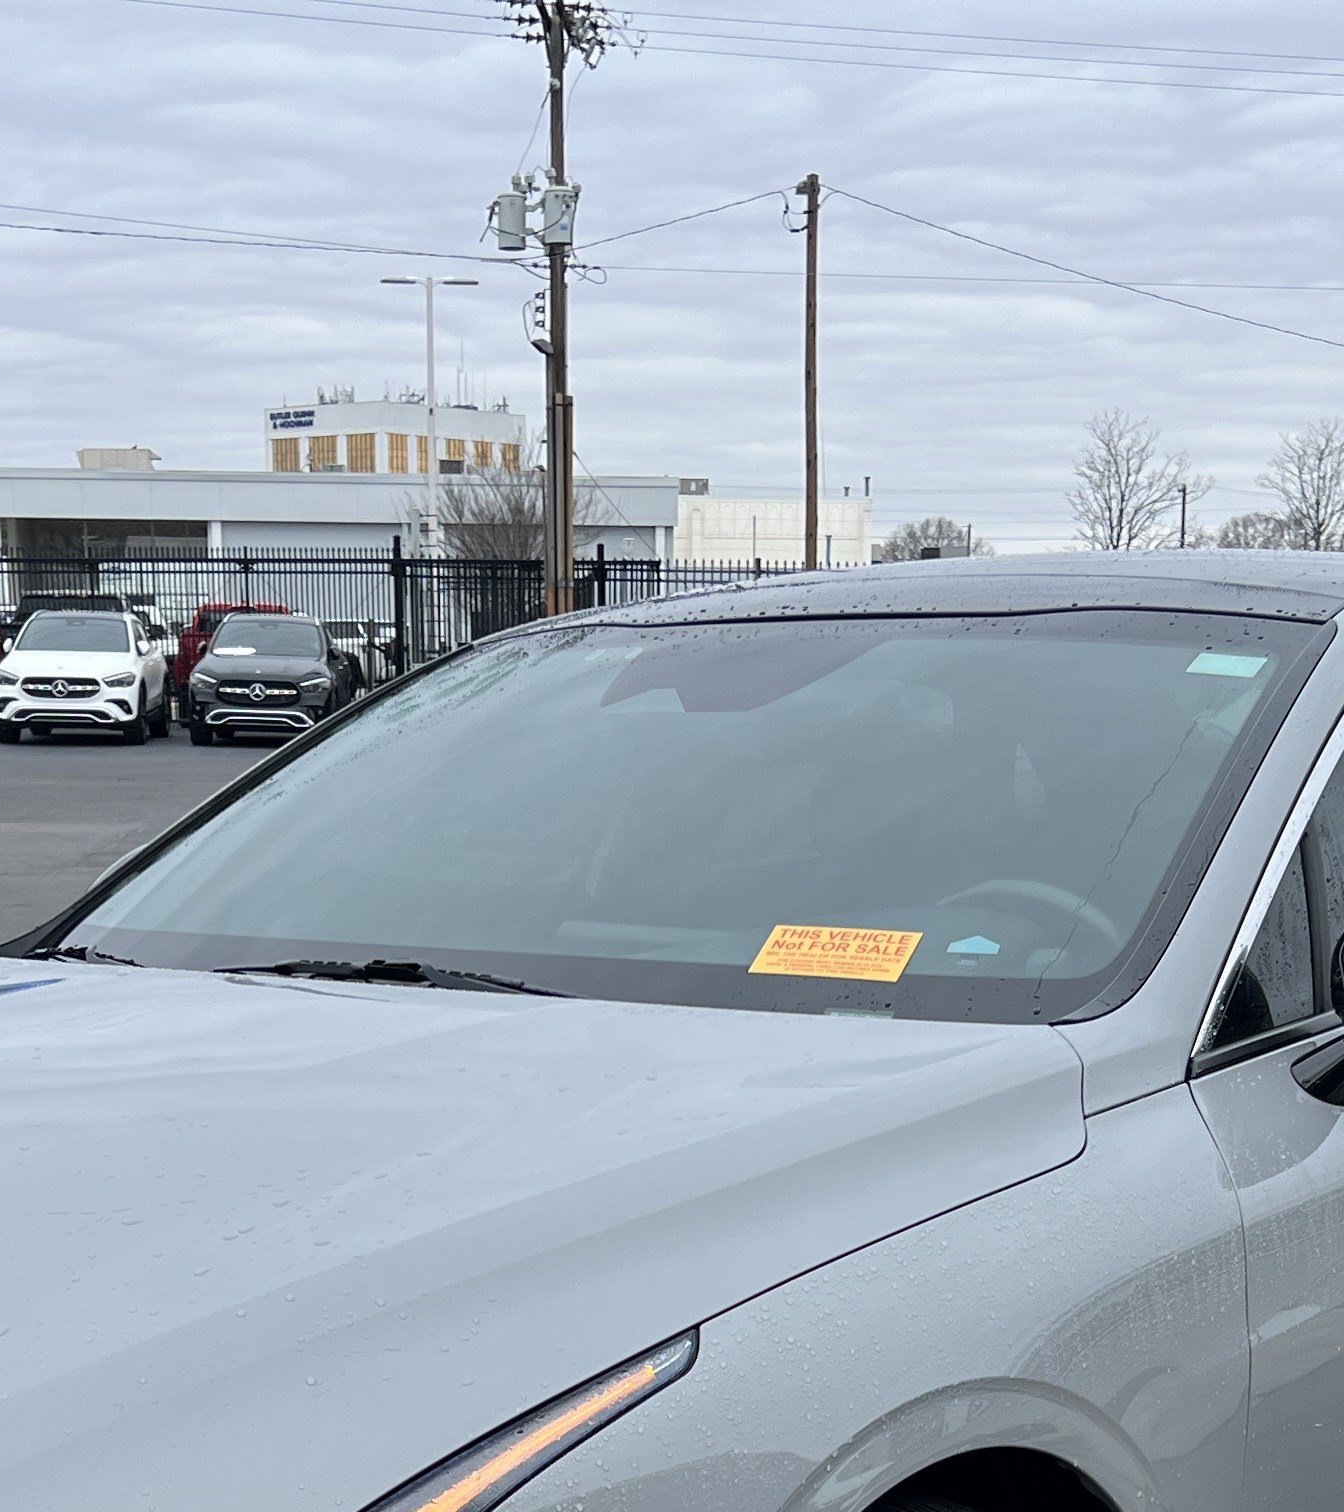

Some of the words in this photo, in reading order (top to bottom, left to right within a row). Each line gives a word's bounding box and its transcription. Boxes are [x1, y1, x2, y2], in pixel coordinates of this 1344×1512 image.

[780, 928, 823, 939] THIS
[829, 931, 913, 946] VEHICLE
[771, 940, 802, 951] Not
[808, 942, 848, 953] FOR
[854, 944, 909, 957] SALE
